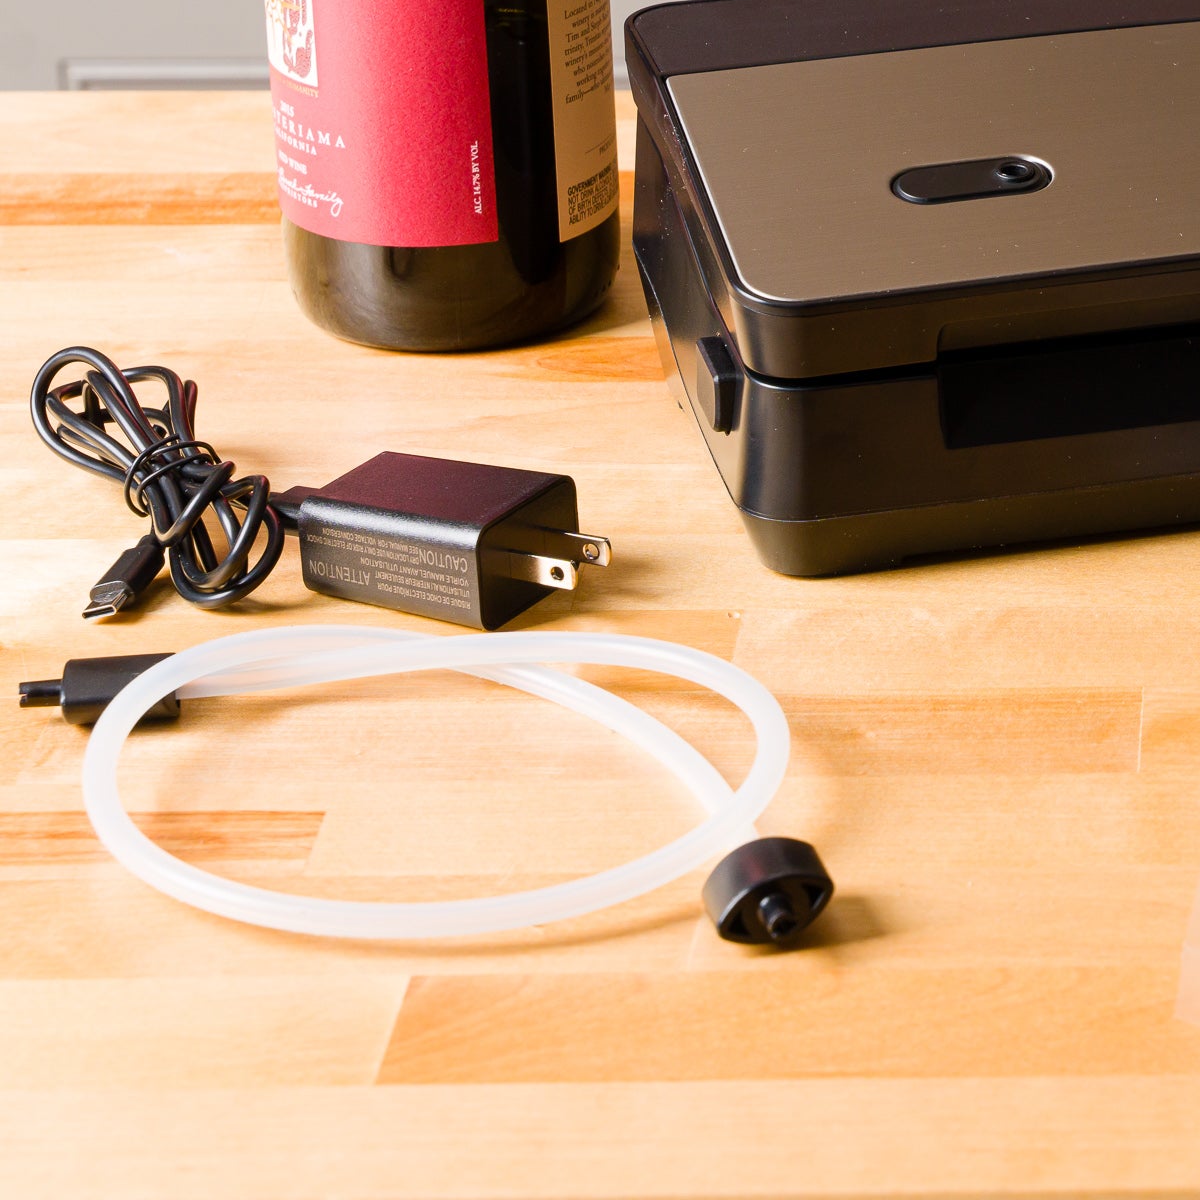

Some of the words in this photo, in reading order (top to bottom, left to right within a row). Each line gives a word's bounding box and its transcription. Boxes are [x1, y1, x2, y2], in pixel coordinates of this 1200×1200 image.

[470, 140, 479, 161] VOL.
[471, 162, 480, 173] BY
[472, 174, 481, 195] 14.7%
[567, 174, 598, 196] GOVERNMENT
[473, 196, 482, 214] ALC.
[568, 195, 579, 206] NOT
[568, 205, 576, 215] OF
[577, 199, 592, 212] BIRTH
[306, 534, 323, 544] SHOCK
[321, 527, 354, 541] CONVERSION
[354, 533, 377, 545] VOLTAGE
[323, 537, 346, 549] ELECTRIC
[346, 542, 353, 550] OF
[353, 543, 364, 552] RISK
[377, 539, 388, 548] FOR
[389, 542, 409, 552] MANUAL
[364, 546, 376, 556] ONLY
[376, 548, 386, 557] USE
[409, 545, 419, 554] SEE
[386, 551, 410, 562] LOCATION
[419, 549, 468, 572] CAUTION
[360, 557, 399, 571] UTILISATION
[309, 559, 370, 585] ATTENTION
[399, 565, 419, 576] AVANT
[418, 569, 445, 581] MANUEL
[375, 571, 405, 584] SEULEMENT
[377, 582, 392, 592] POUR
[426, 592, 442, 603] CHOC
[442, 596, 450, 604] DE
[451, 598, 471, 609] RISQUE
